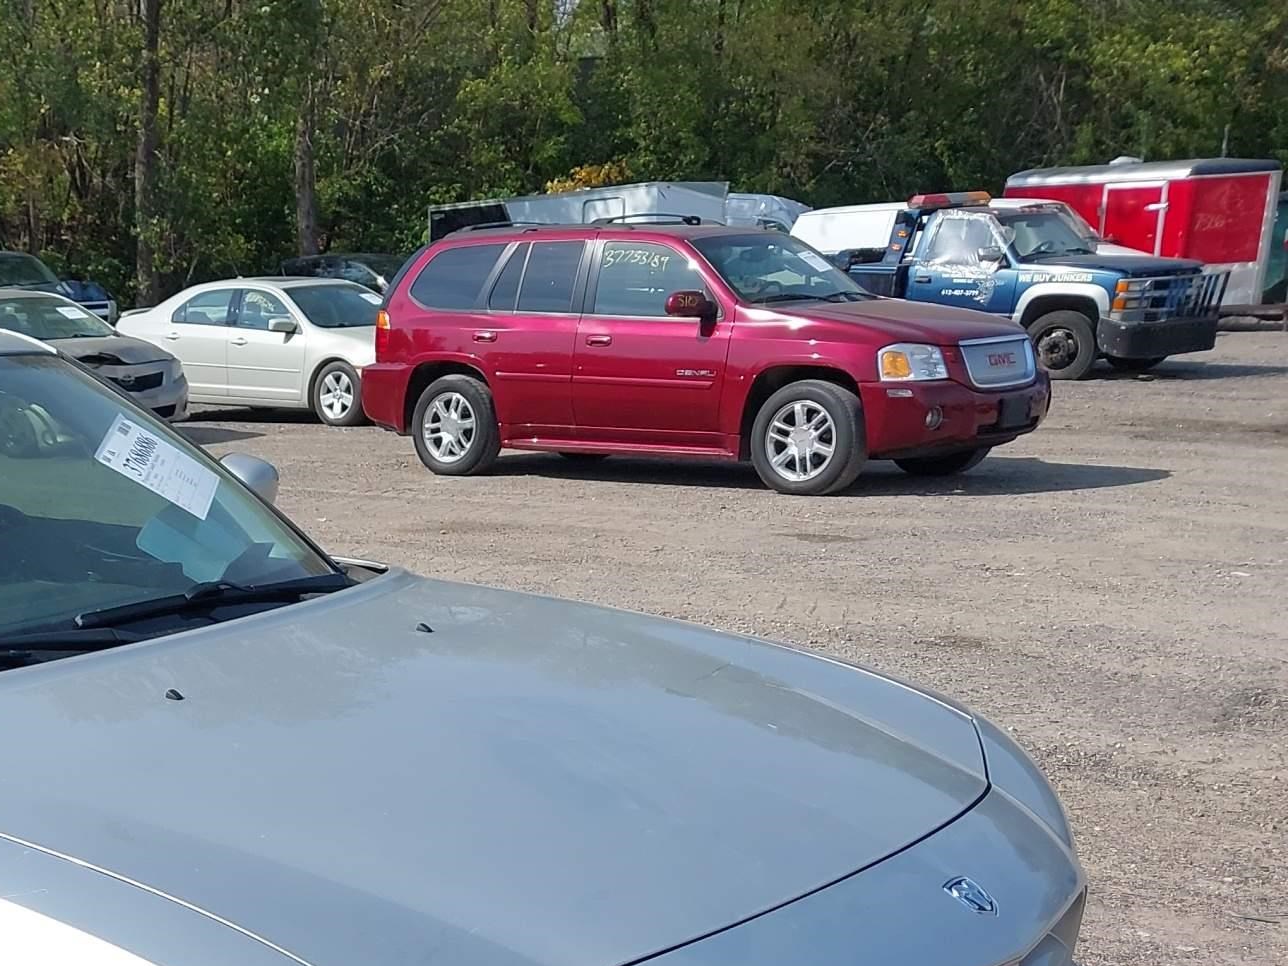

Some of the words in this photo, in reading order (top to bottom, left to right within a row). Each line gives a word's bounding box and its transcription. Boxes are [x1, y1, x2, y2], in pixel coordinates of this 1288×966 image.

[1018, 273, 1031, 282] WE
[1033, 273, 1051, 282] BUY
[1052, 273, 1093, 282] JUNKERS
[987, 353, 1017, 367] GMC
[123, 432, 158, 477] 37686886
